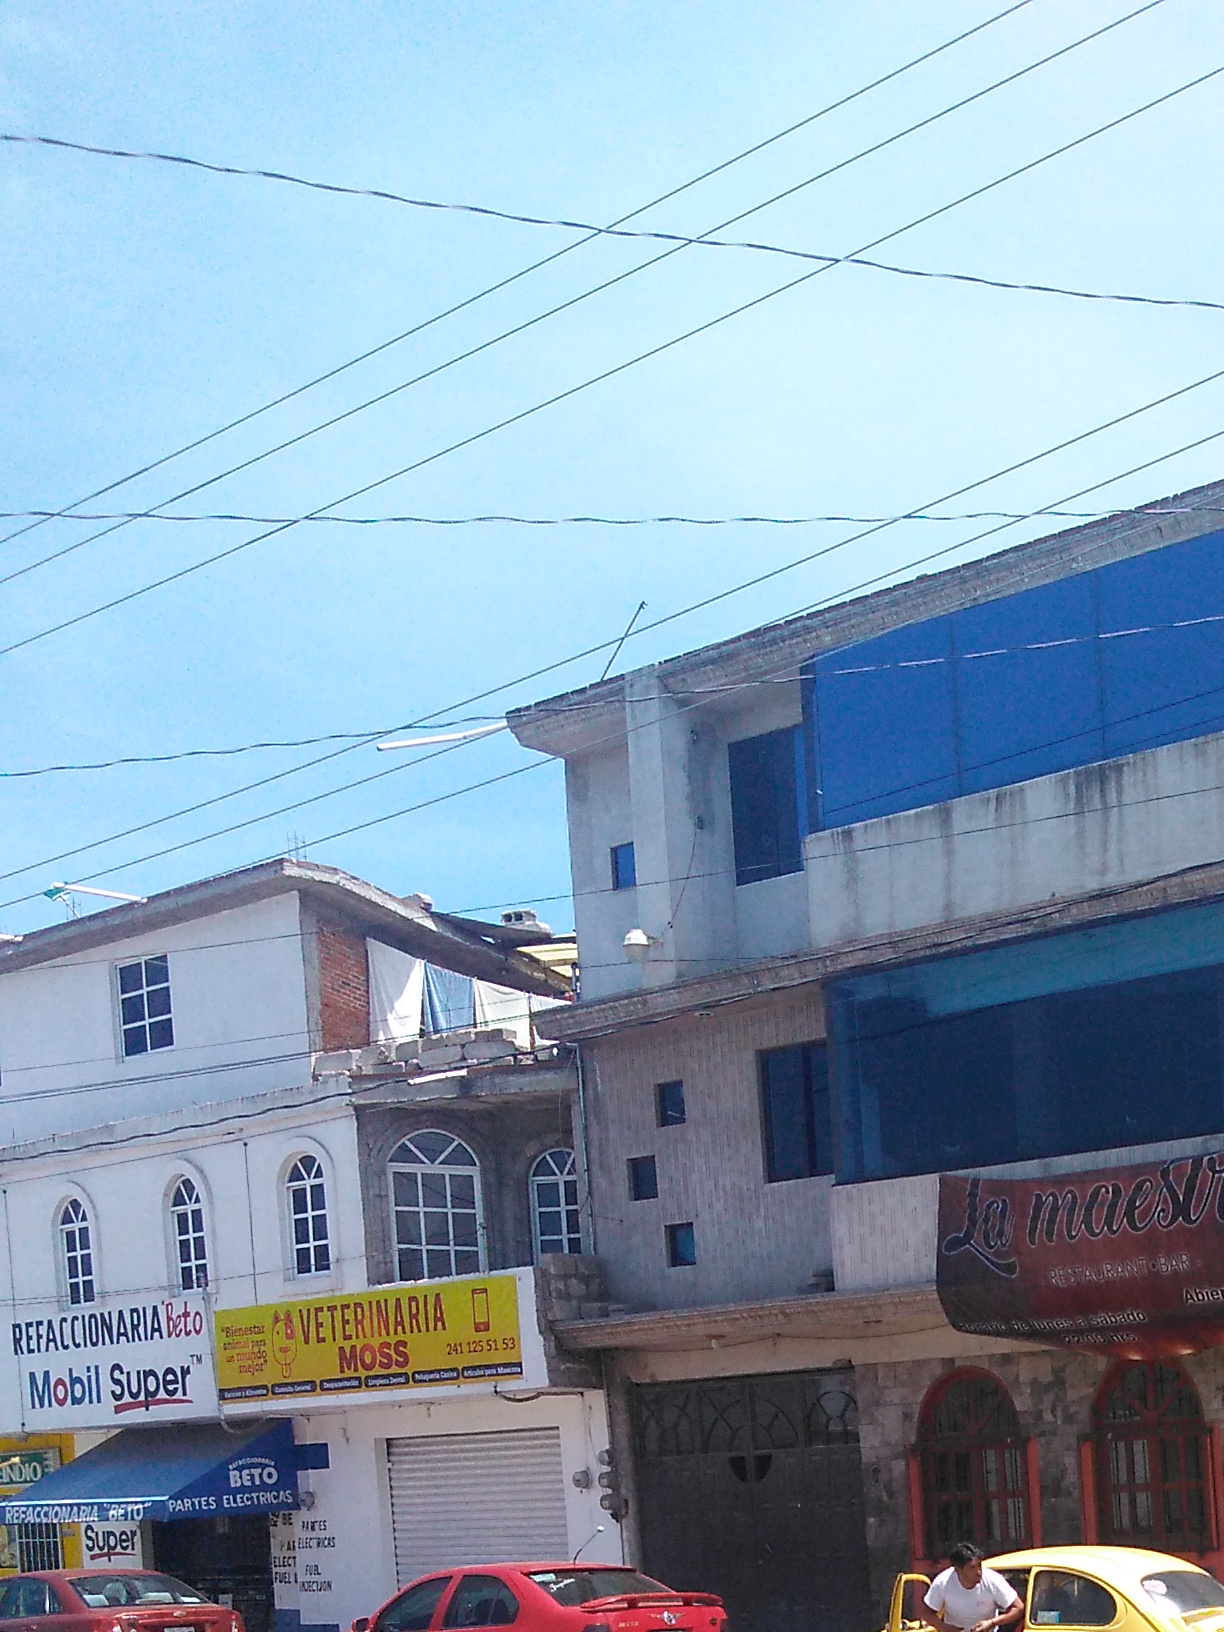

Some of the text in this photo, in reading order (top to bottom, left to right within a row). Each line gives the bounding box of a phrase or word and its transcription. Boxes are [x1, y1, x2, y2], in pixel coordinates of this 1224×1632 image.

[942, 1178, 1018, 1278] La
[1049, 1252, 1192, 1288] RESTAURANT BAR
[11, 1304, 164, 1356] REFACCIONARIA
[298, 1292, 447, 1346] VETERINARIA
[1032, 1318, 1074, 1331] lunes
[236, 1348, 268, 1362] mundo
[338, 1340, 410, 1374] MOSS
[447, 1337, 516, 1356] 241 125 51 53
[28, 1364, 102, 1410] Mobil
[110, 1362, 192, 1411] Super
[229, 1466, 278, 1488] BETO
[168, 1490, 293, 1512] PARTES ELECTRICAS
[5, 1504, 99, 1525] REFACCIONARIA
[301, 1520, 327, 1532] PARTES
[84, 1523, 138, 1562] Super
[297, 1536, 336, 1550] ELECTRICAS
[274, 1571, 292, 1584] FUEL
[305, 1564, 322, 1576] FUEL
